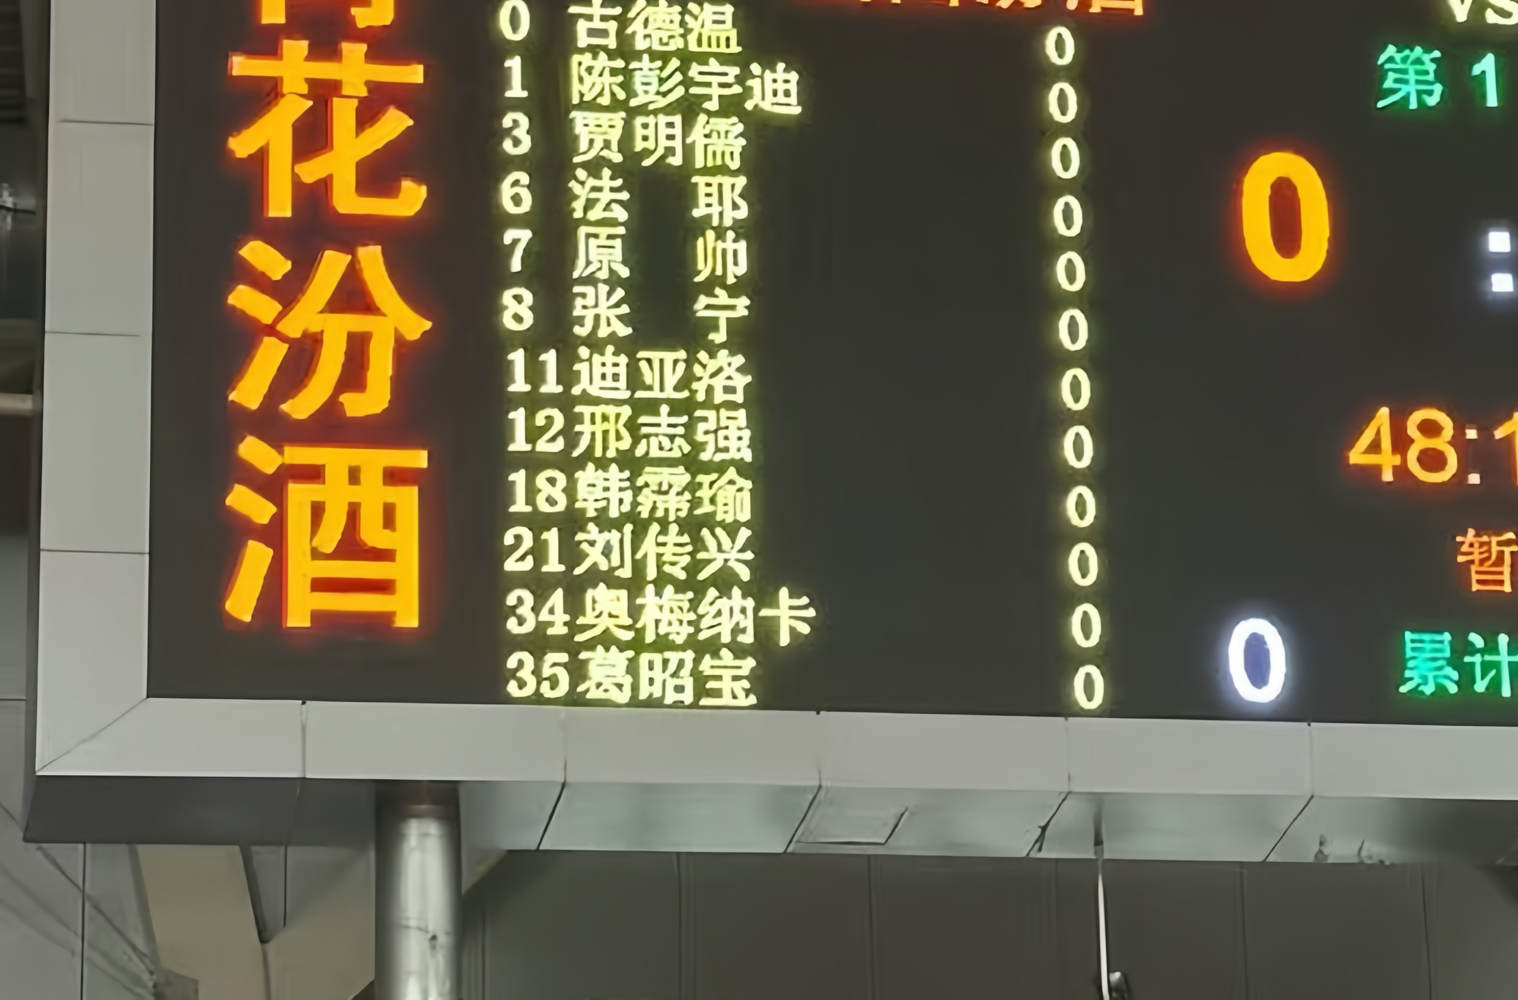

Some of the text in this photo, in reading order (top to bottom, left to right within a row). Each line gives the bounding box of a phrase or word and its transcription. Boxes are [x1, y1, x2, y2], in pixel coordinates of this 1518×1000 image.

[499, 0, 530, 41] 0
[1045, 26, 1074, 65] 0
[504, 51, 802, 115] 1 陈彭宇迪
[1048, 82, 1077, 123] 0
[502, 111, 746, 170] 3 贾明儒
[1051, 137, 1080, 179] 0
[501, 171, 532, 214] 6
[1053, 195, 1082, 236] 0
[1242, 152, 1329, 282] 0
[504, 229, 532, 272] 7
[1056, 251, 1085, 291] 0
[502, 287, 533, 331] 8
[1059, 309, 1088, 351] 0
[571, 345, 752, 404] 迪亚洛
[1061, 368, 1090, 410] 0
[571, 404, 752, 462] 邢志强
[1063, 426, 1093, 468] 0
[1066, 486, 1096, 527] 0
[573, 522, 754, 581] 刘传兴
[1068, 542, 1098, 586] 0
[574, 582, 816, 646] 奥梅纳卡
[1071, 603, 1101, 647] 0
[577, 647, 757, 706] 葛昭宝
[1228, 618, 1287, 703] 0
[1074, 665, 1104, 709] 0
